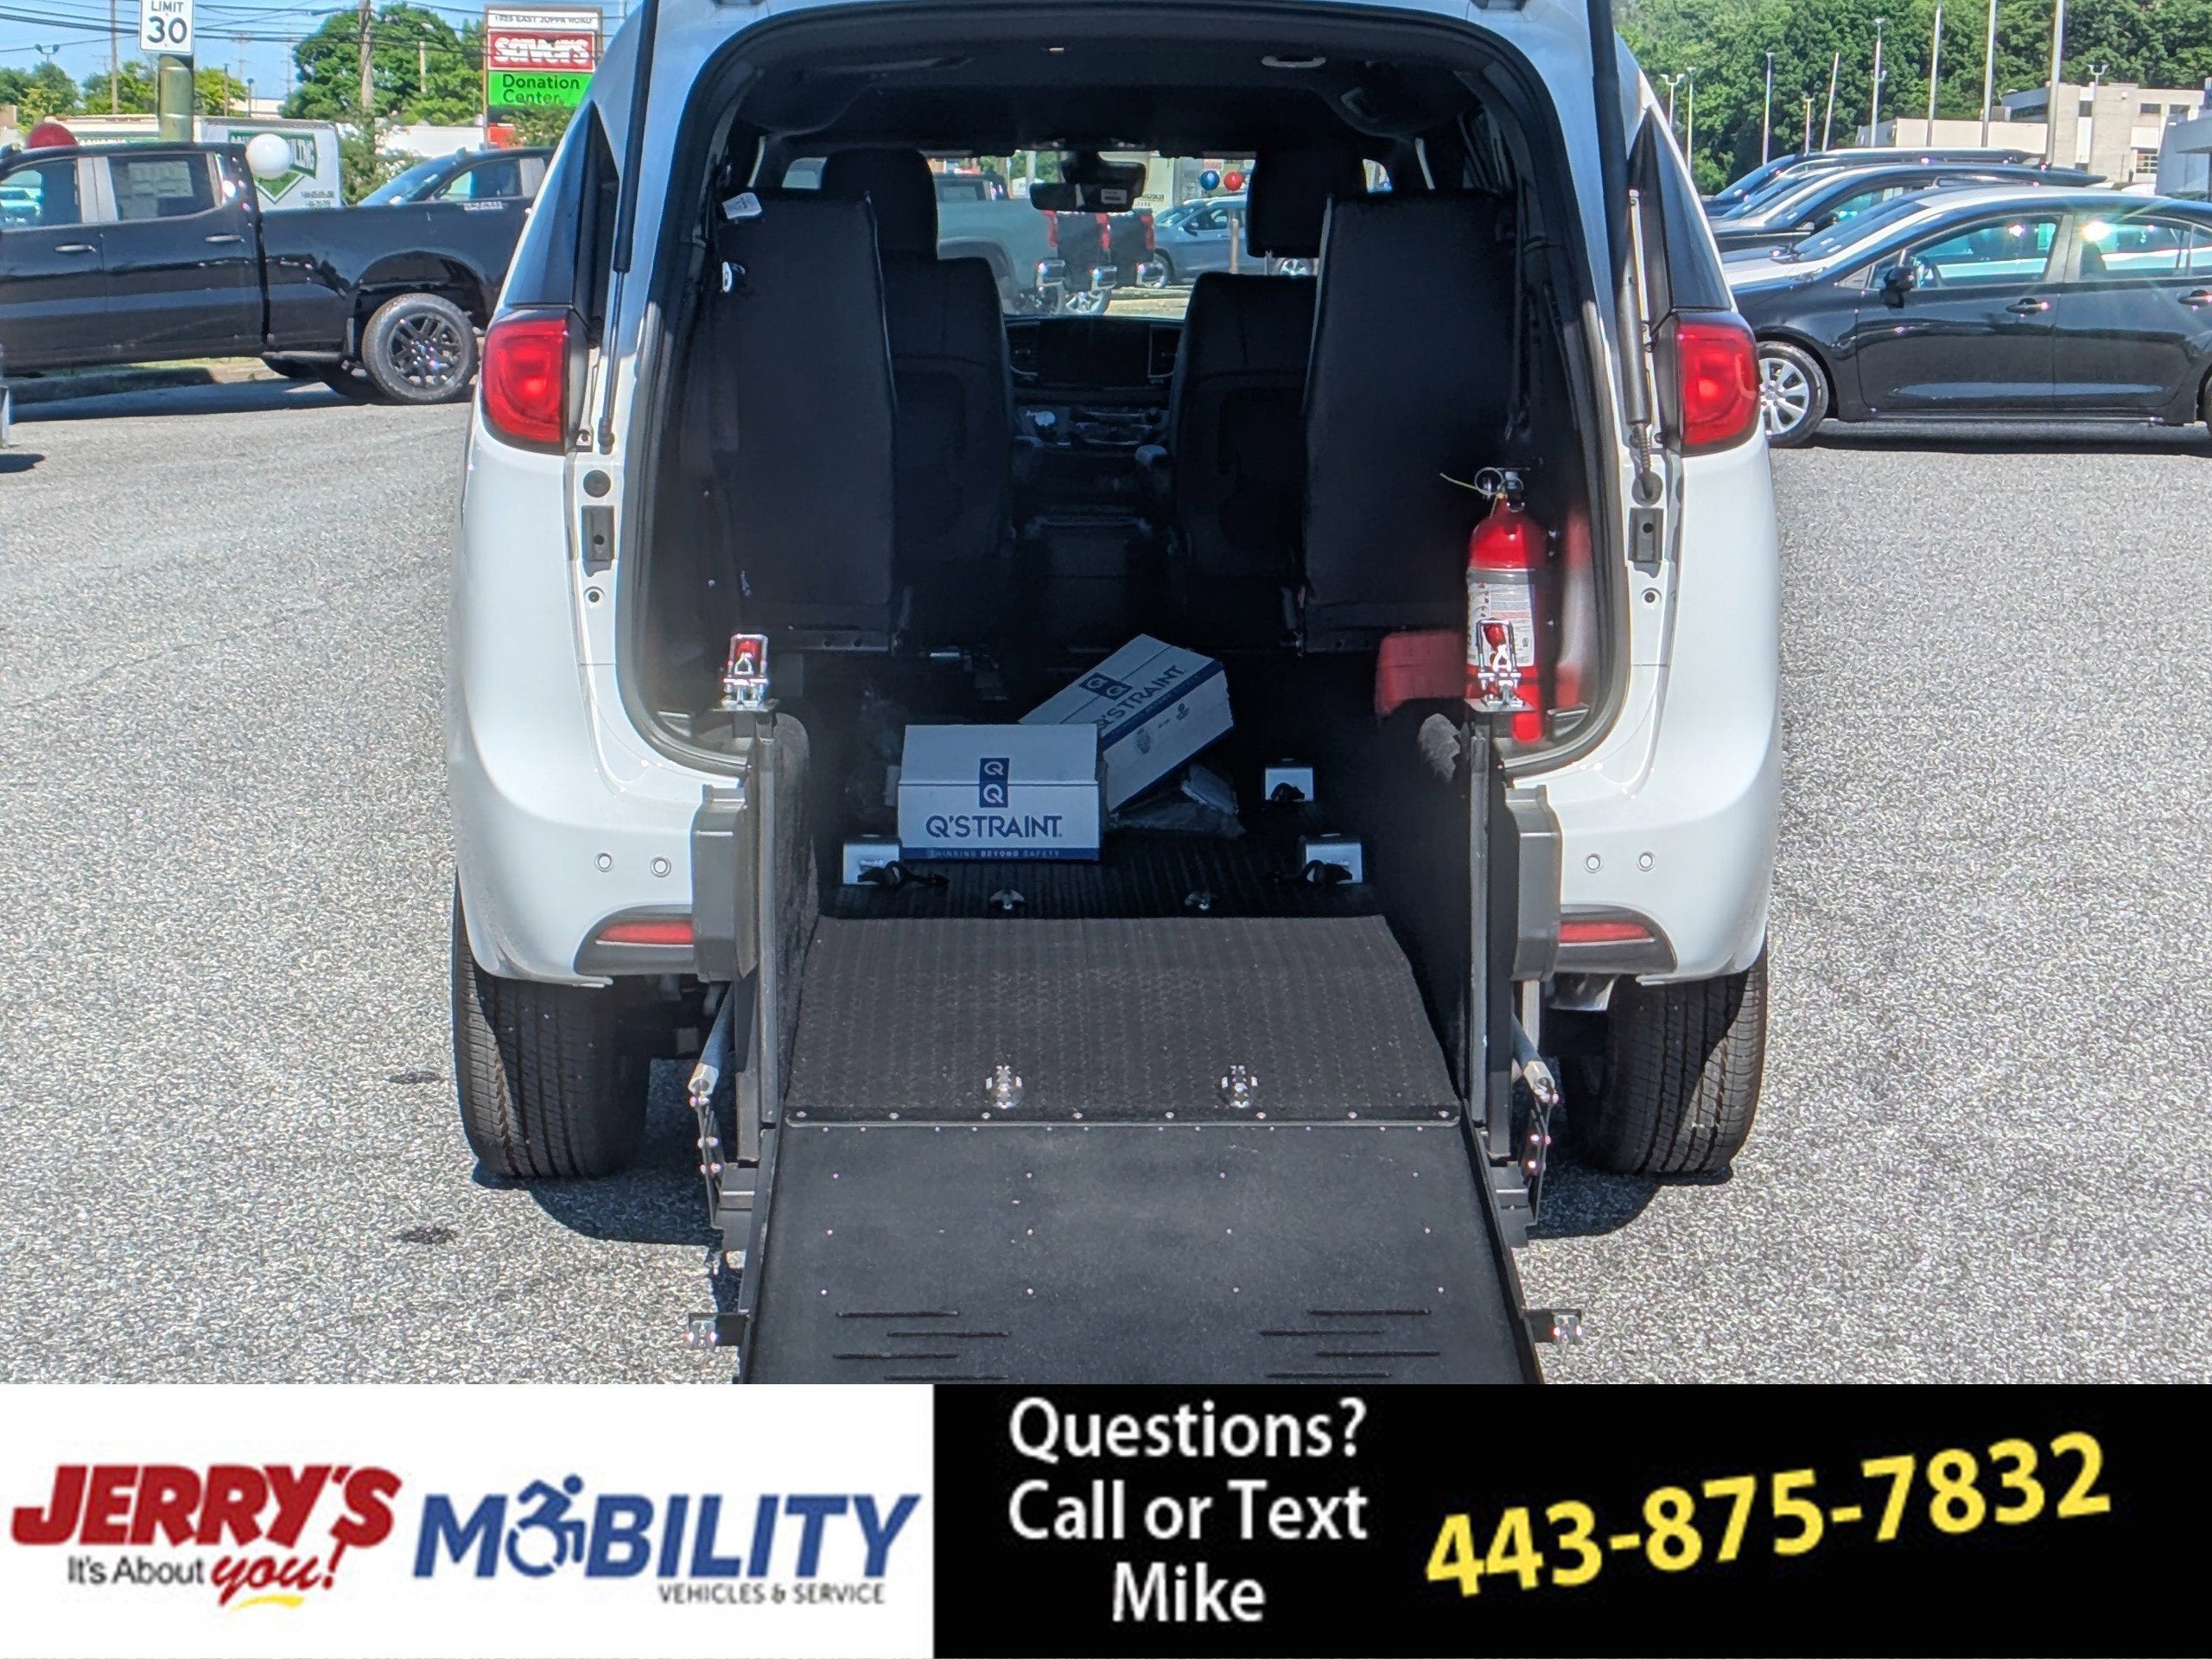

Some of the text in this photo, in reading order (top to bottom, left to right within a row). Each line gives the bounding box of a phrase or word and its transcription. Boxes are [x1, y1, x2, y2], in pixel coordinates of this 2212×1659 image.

[150, 0, 184, 12] LIMIT
[146, 16, 188, 44] 30
[502, 73, 580, 90] Donation
[503, 88, 561, 105] Center
[982, 784, 1004, 804] Q
[925, 815, 1063, 838] Q'STRAINT
